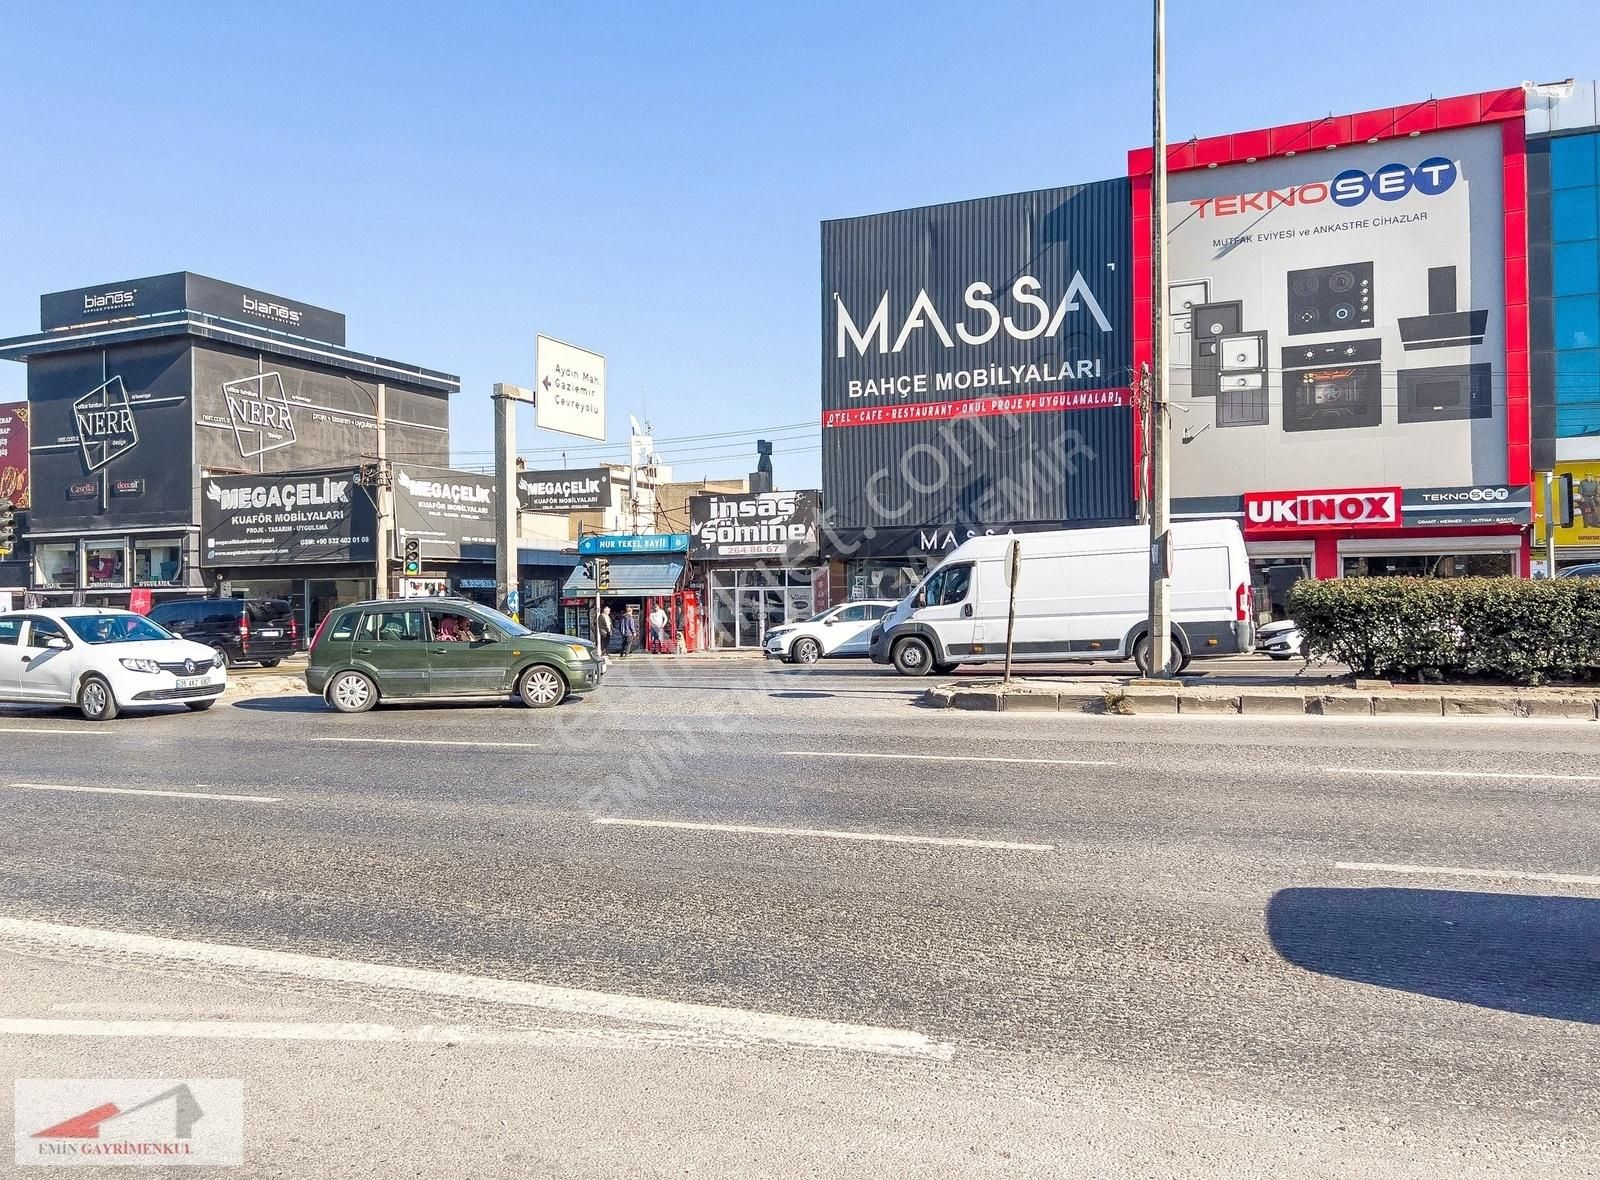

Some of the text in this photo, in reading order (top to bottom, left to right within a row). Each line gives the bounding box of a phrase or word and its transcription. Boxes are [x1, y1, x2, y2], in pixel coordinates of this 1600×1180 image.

[1190, 160, 1455, 219] TEKNOSET
[1213, 212, 1428, 248] MUTFAK EVİYESİ ve ANKASTRE CİHAZLAR
[837, 269, 1113, 358] MASSA
[555, 363, 601, 386] Aydın Mah.
[848, 359, 1101, 398] BAHÇE MOBİLYALARI
[554, 378, 596, 397] Gaziemir
[228, 397, 291, 431] NERR
[554, 394, 599, 415] Çevreyolu
[829, 391, 1119, 424] OTEL CAFE RESTAURANT OKUL PROJE ve UYGULAMALARI
[78, 409, 133, 436] NERR
[220, 478, 349, 511] MEGAÇELİK
[409, 480, 491, 503] MEGAÇELİK
[527, 478, 600, 498] MEGAÇELİK
[1423, 488, 1509, 501] TEKNOSET
[418, 501, 446, 510] KUAFÖR
[558, 496, 598, 504] MOBİLYALARI
[1248, 495, 1392, 524] UKINOX
[231, 510, 344, 525] KUAFÖR MOBİLYALARI
[600, 541, 615, 549] NUR
[618, 539, 642, 548] TEKEL
[727, 546, 746, 554] 264
[766, 545, 779, 553] 67
